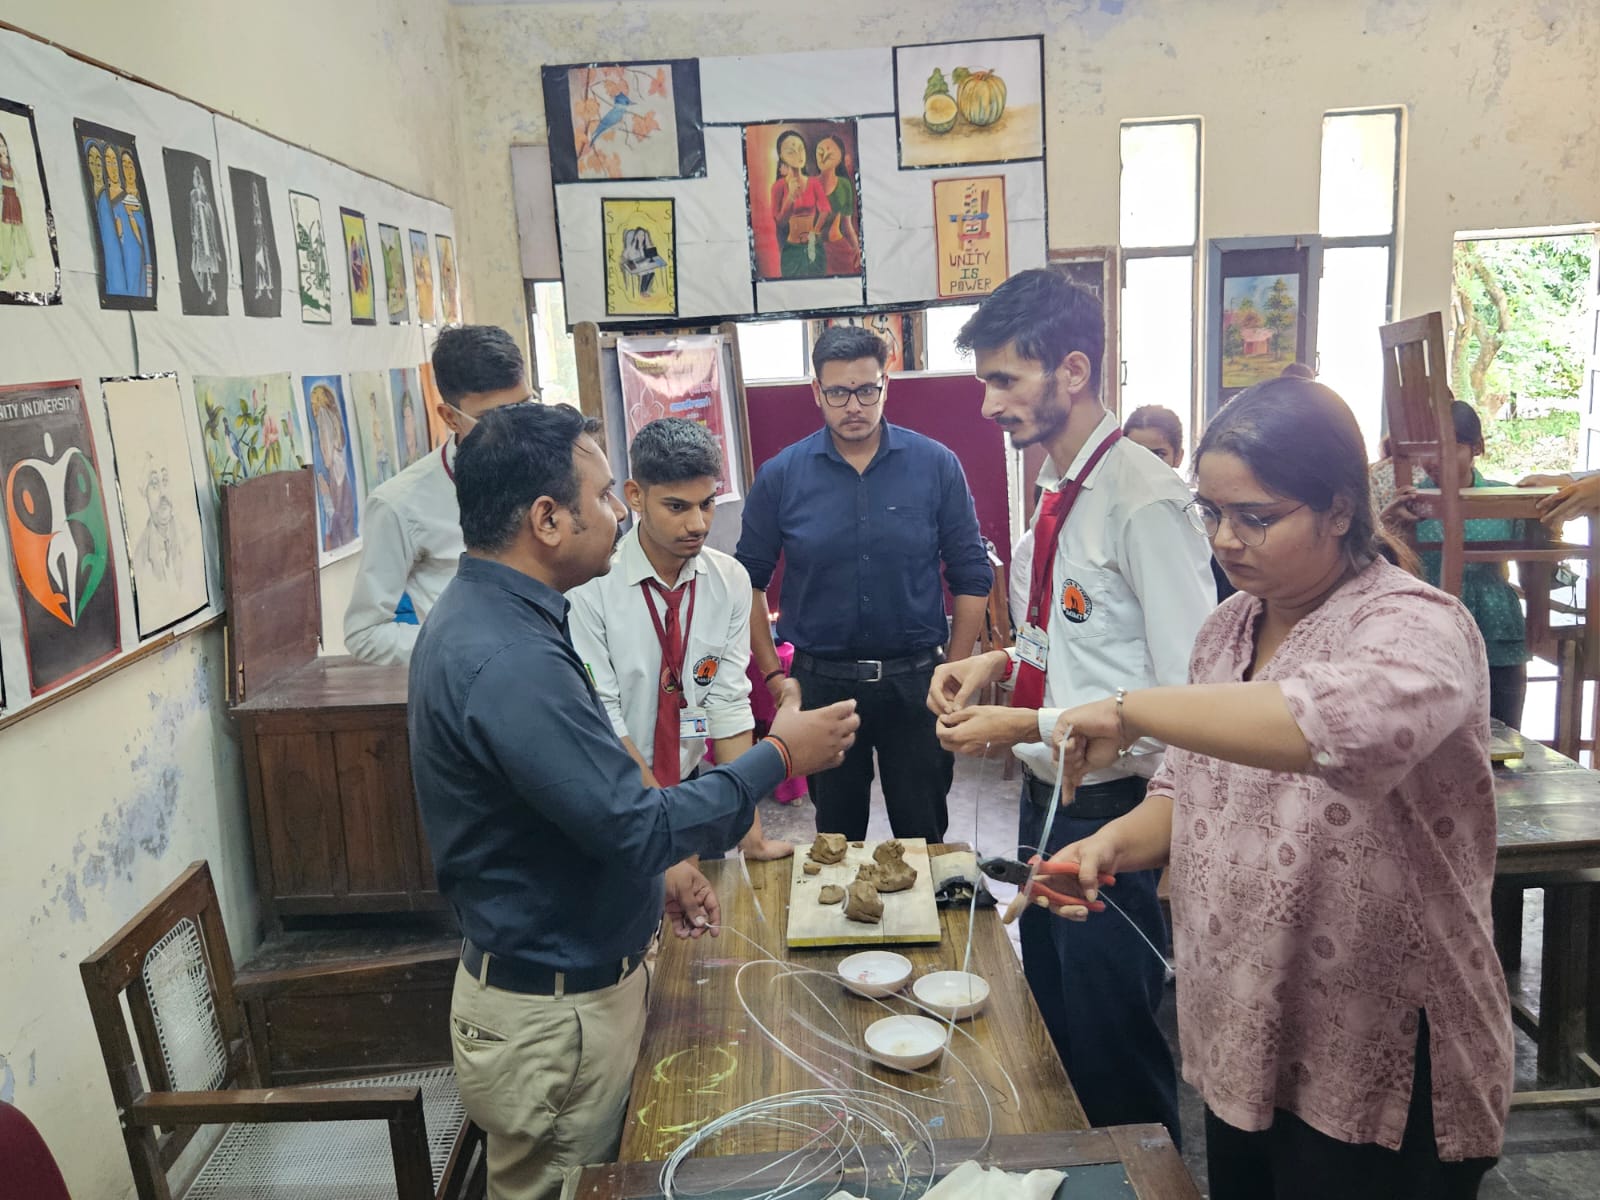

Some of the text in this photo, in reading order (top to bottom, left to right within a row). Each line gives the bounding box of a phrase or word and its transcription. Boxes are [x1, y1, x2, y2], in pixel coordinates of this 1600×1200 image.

[949, 250, 990, 267] UNITY
[960, 267, 979, 280] IS
[950, 278, 992, 294] POWER
